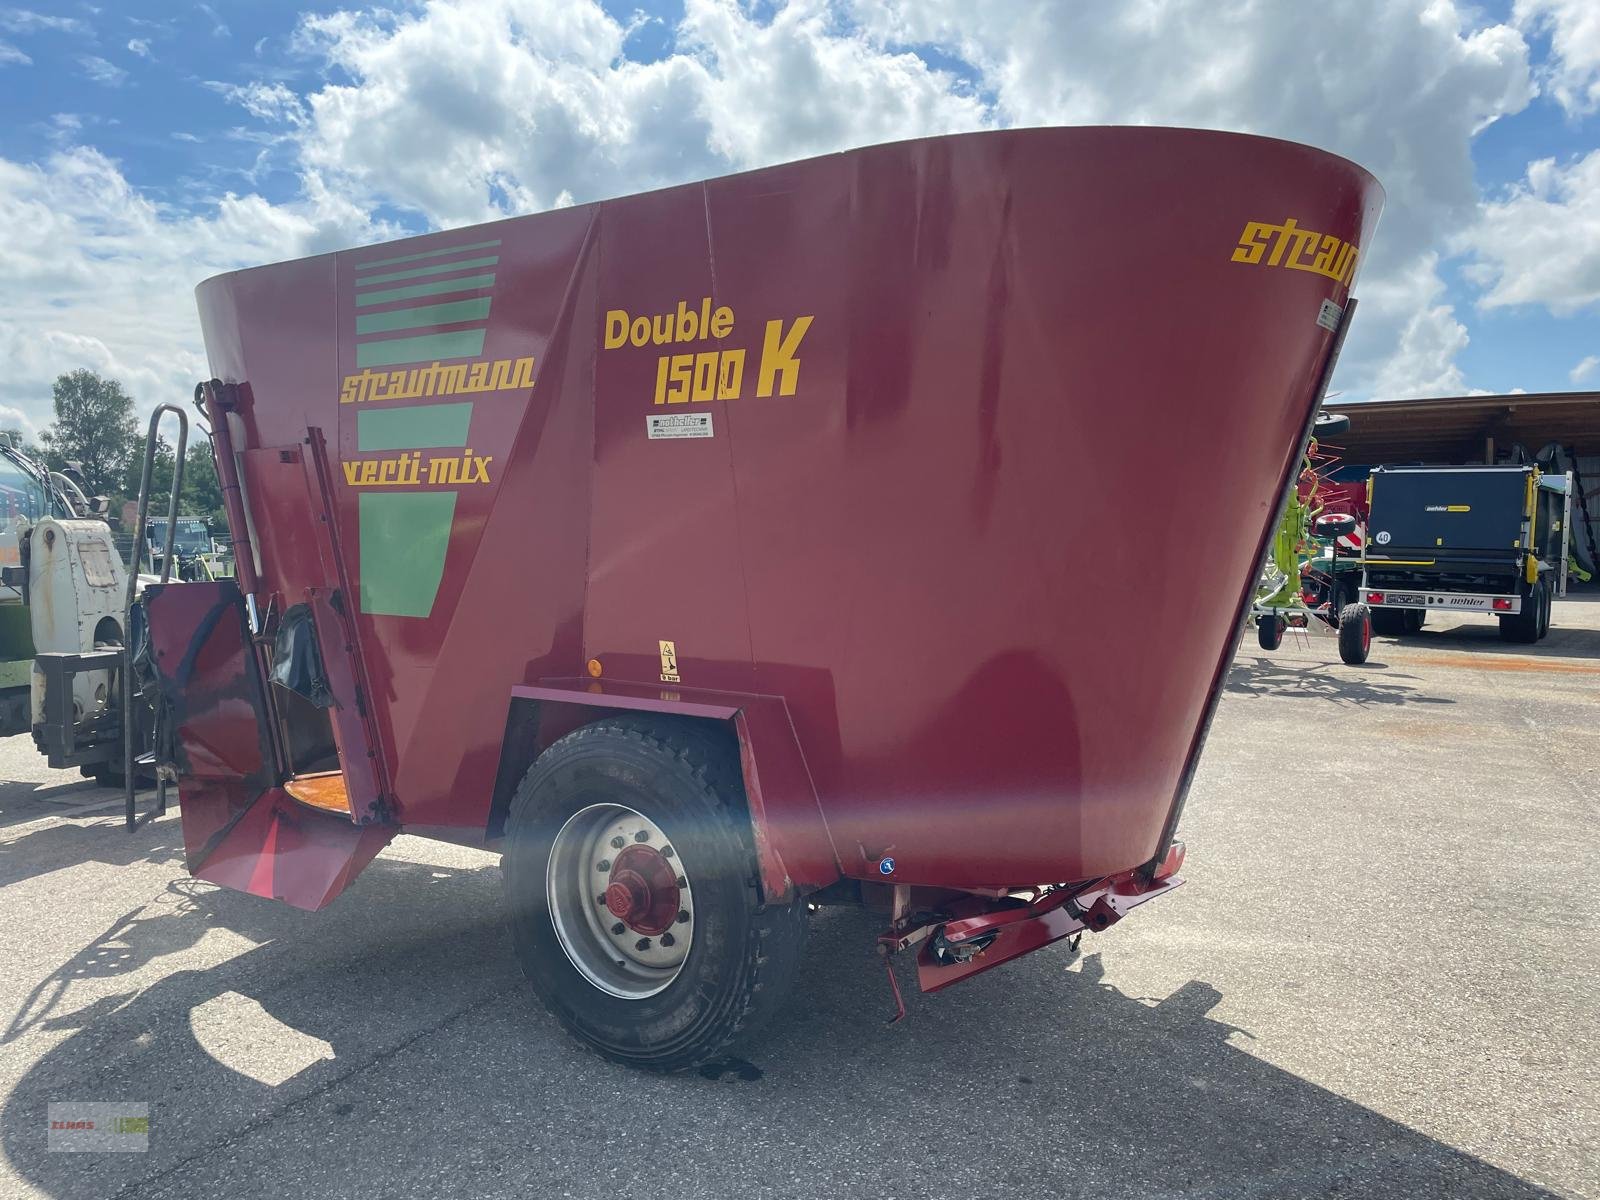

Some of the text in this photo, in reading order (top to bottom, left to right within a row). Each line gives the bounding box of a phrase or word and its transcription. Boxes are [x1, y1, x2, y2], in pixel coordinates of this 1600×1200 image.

[604, 297, 735, 350] Double
[339, 357, 536, 404] strautmann
[654, 315, 815, 405] 1500 K
[342, 448, 493, 486] verti-mix
